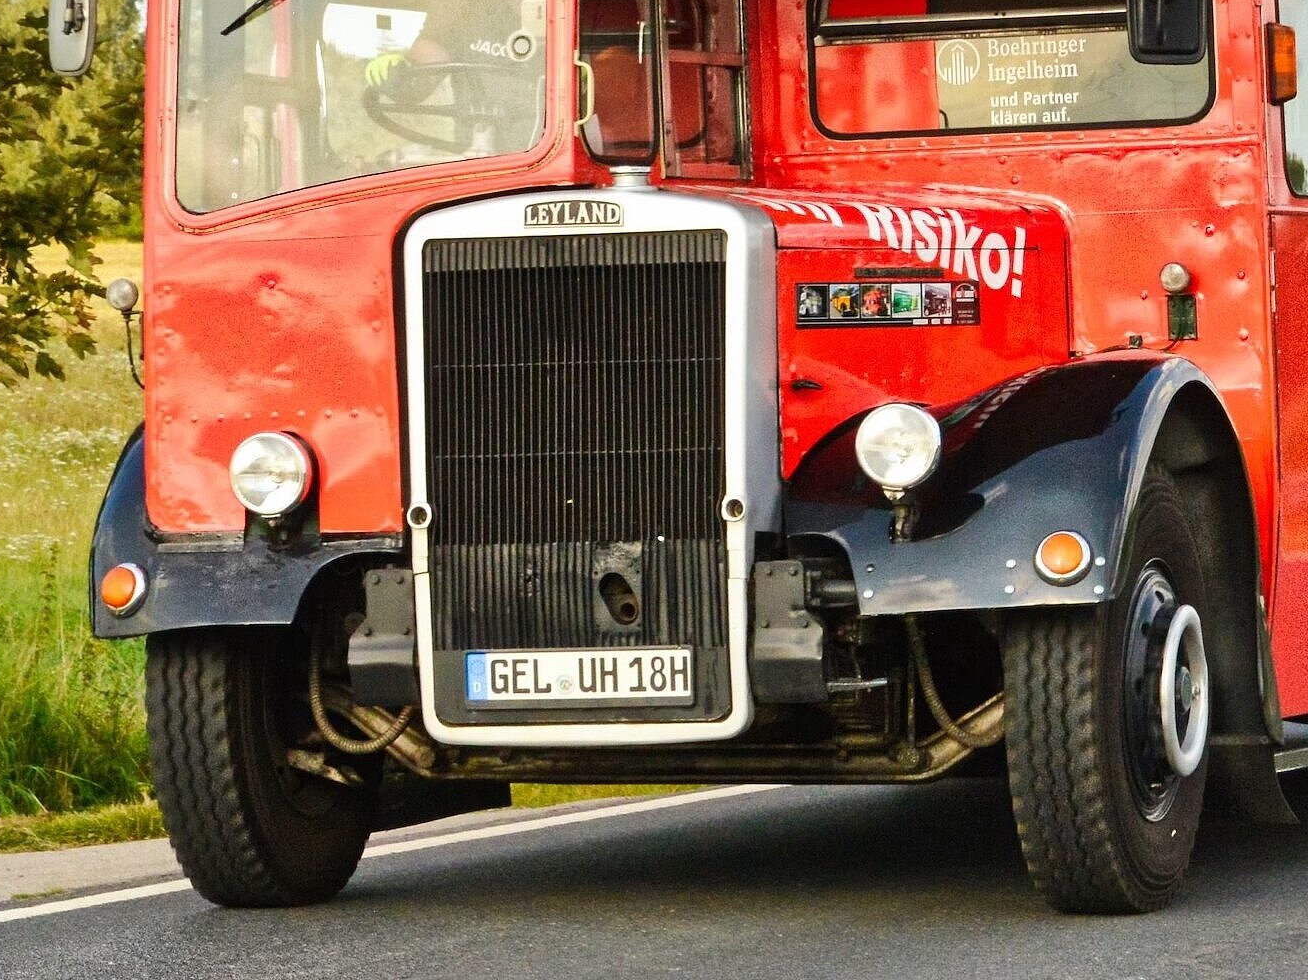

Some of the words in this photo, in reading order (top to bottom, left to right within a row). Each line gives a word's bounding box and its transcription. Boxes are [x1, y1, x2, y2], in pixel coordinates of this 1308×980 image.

[987, 34, 1087, 58] Boehringer
[987, 58, 1079, 85] Ingelheim
[990, 90, 1018, 108] und
[1023, 90, 1080, 106] Partner
[991, 109, 1037, 126] klären
[1042, 106, 1071, 123] auf.
[525, 202, 622, 226] LEYLAND
[473, 681, 482, 693] D
[490, 658, 552, 695] GEL
[578, 657, 619, 694] UH
[628, 655, 689, 693] 18H
